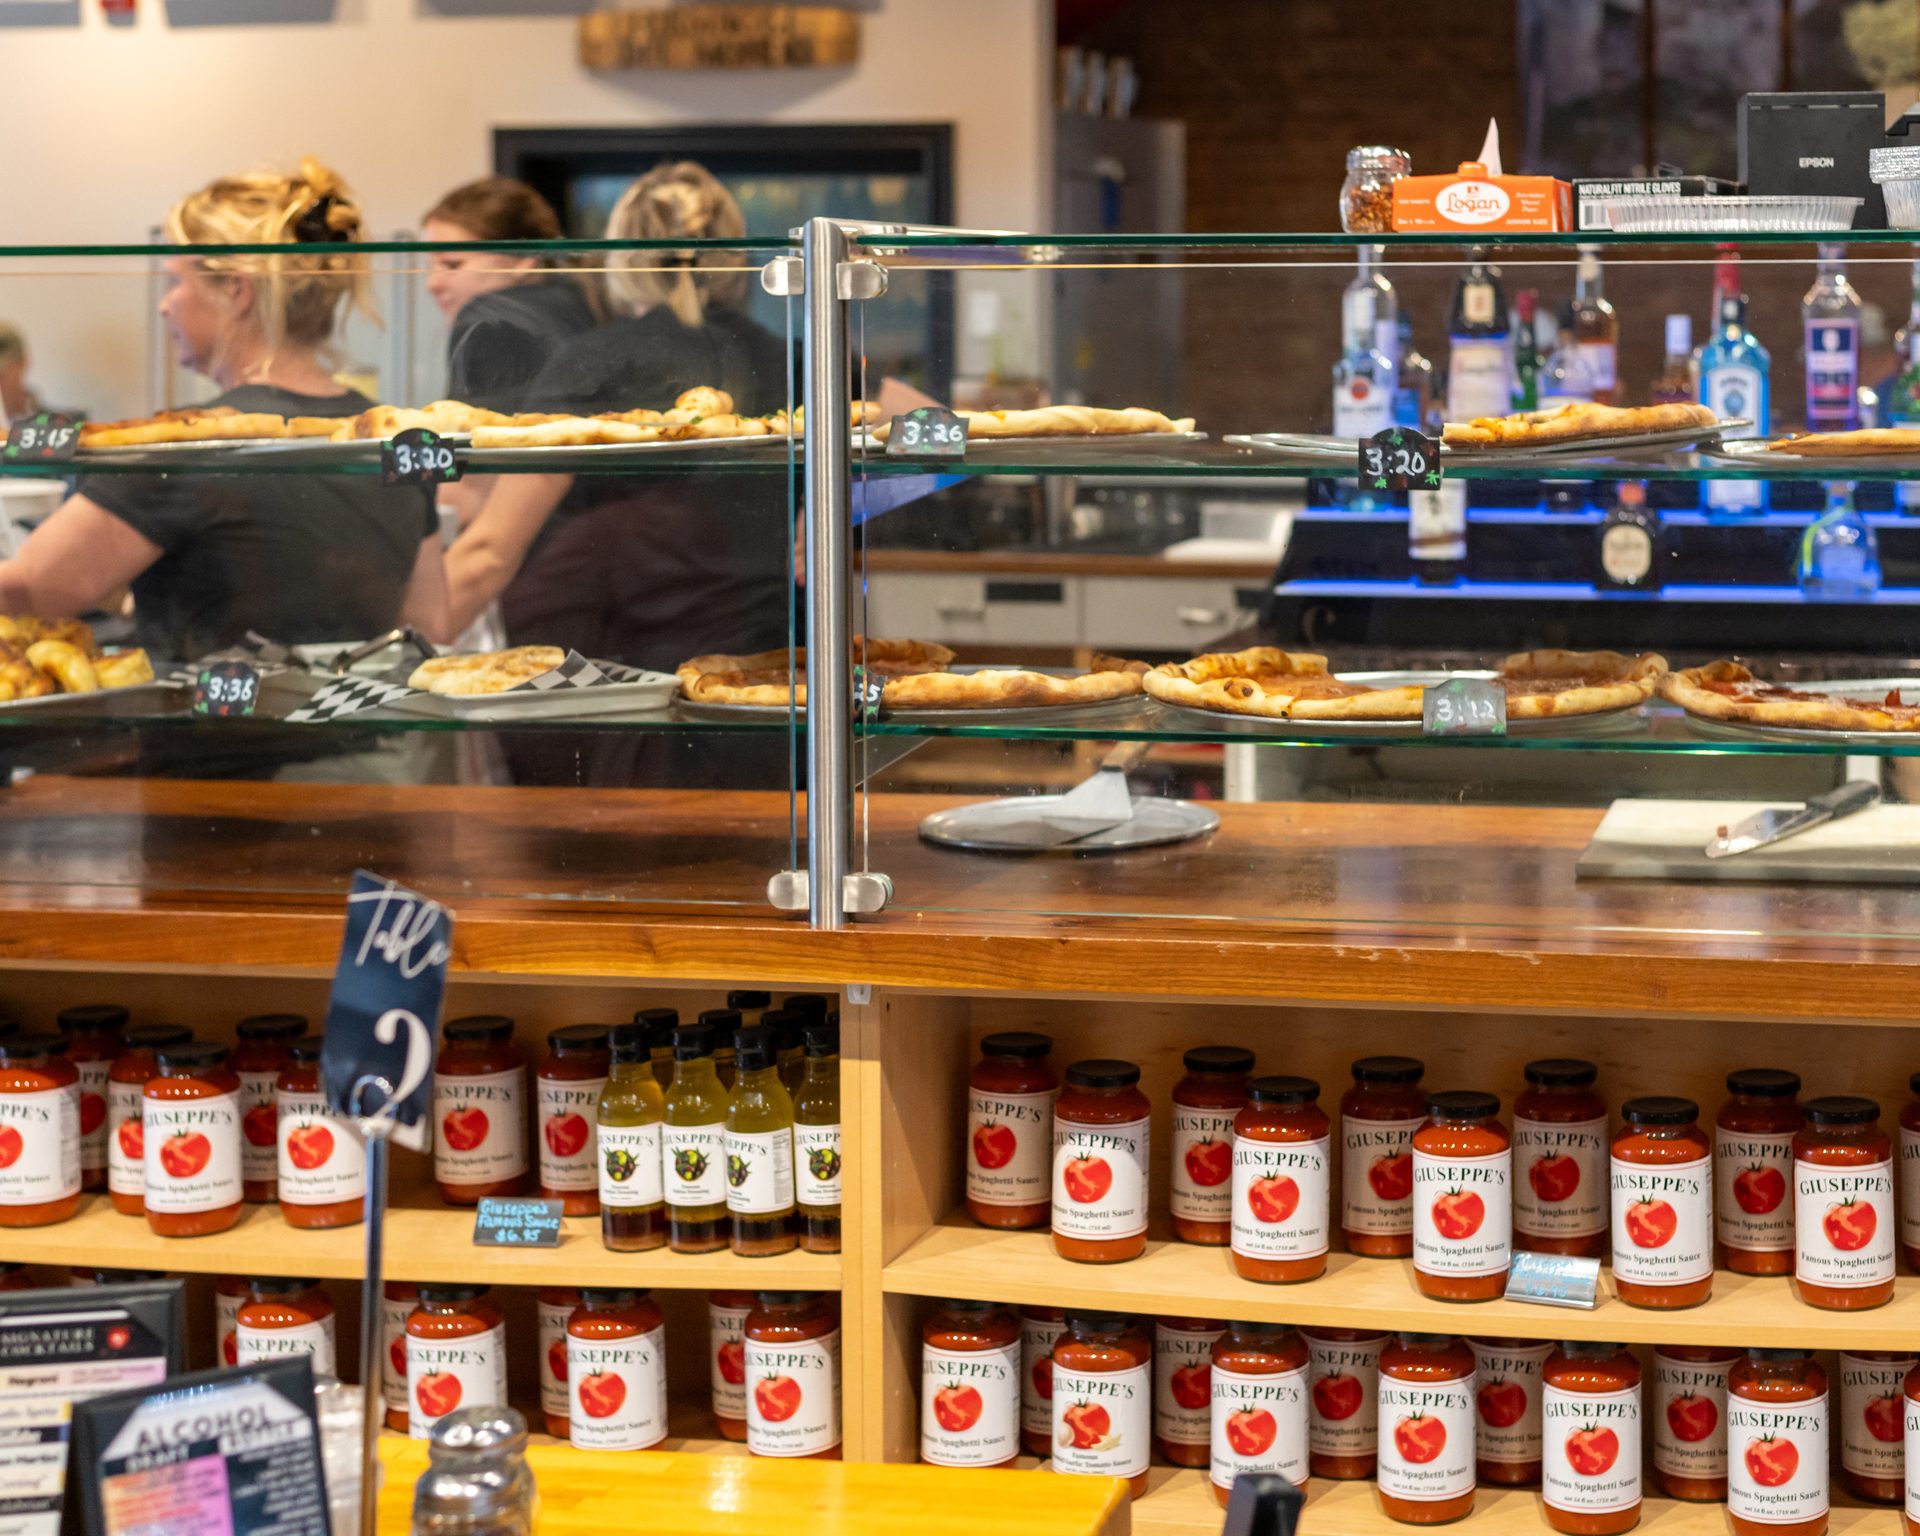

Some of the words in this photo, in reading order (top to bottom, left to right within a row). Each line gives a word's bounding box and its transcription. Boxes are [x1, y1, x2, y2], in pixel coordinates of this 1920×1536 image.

[1798, 157, 1835, 168] EPSON
[1578, 183, 1623, 195] NATURALFIT
[1623, 183, 1651, 194] NITRILE
[1651, 182, 1681, 193] GLOVES
[1446, 193, 1502, 213] Logan
[19, 427, 74, 448] 3:15
[902, 421, 963, 445] 3:26
[395, 443, 454, 475] 3:20
[1365, 447, 1426, 476] 3:20
[208, 677, 255, 702] 3:36
[355, 1008, 432, 1151] 2
[1717, 1142, 1792, 1160] GIUSEPPE
[1233, 1151, 1322, 1171] GIUSEPPE'S
[1414, 1167, 1505, 1185] GIUSEPPE'S
[1611, 1174, 1700, 1195] GIUSEPPE'S
[1799, 1177, 1892, 1195] GIUSEPPE'S
[1069, 1208, 1110, 1219] Spaghetti
[1111, 1208, 1135, 1217] Sauce
[1537, 1207, 1578, 1217] Spaghetti
[525, 1214, 560, 1229] Sauce
[1741, 1221, 1784, 1231] Spaghetti
[1255, 1227, 1297, 1239] Spaghetti
[1298, 1227, 1320, 1236] Sauce
[1440, 1245, 1483, 1256] Spaghetti
[1485, 1242, 1505, 1252] Sauce
[1633, 1254, 1676, 1265] Spaghetti
[1678, 1252, 1701, 1262] Sauce
[1801, 1252, 1831, 1265] Famous
[1833, 1257, 1876, 1267] Spaghetti
[1655, 1368, 1726, 1389] GIUSEPPE
[1843, 1371, 1904, 1386] GIUSEP
[1212, 1383, 1300, 1403] GIUSEPPE'S
[1379, 1389, 1468, 1410] GIUSEPPE'S
[1545, 1402, 1638, 1420] GIUSEPPE'S
[136, 1405, 271, 1447] ALCOHOL
[1727, 1411, 1821, 1432] GIUSEPPE'S
[982, 1435, 1006, 1446] Sauce
[1674, 1448, 1716, 1458] Spaghetti
[1277, 1459, 1298, 1469] Sauce
[1401, 1470, 1444, 1480] Spaghetti
[1446, 1466, 1467, 1476] Sauce
[1574, 1481, 1617, 1492] Spaghetti
[1618, 1477, 1637, 1487] Sauce
[1753, 1491, 1797, 1503] Spaghetti
[1799, 1489, 1821, 1500] Sauce
